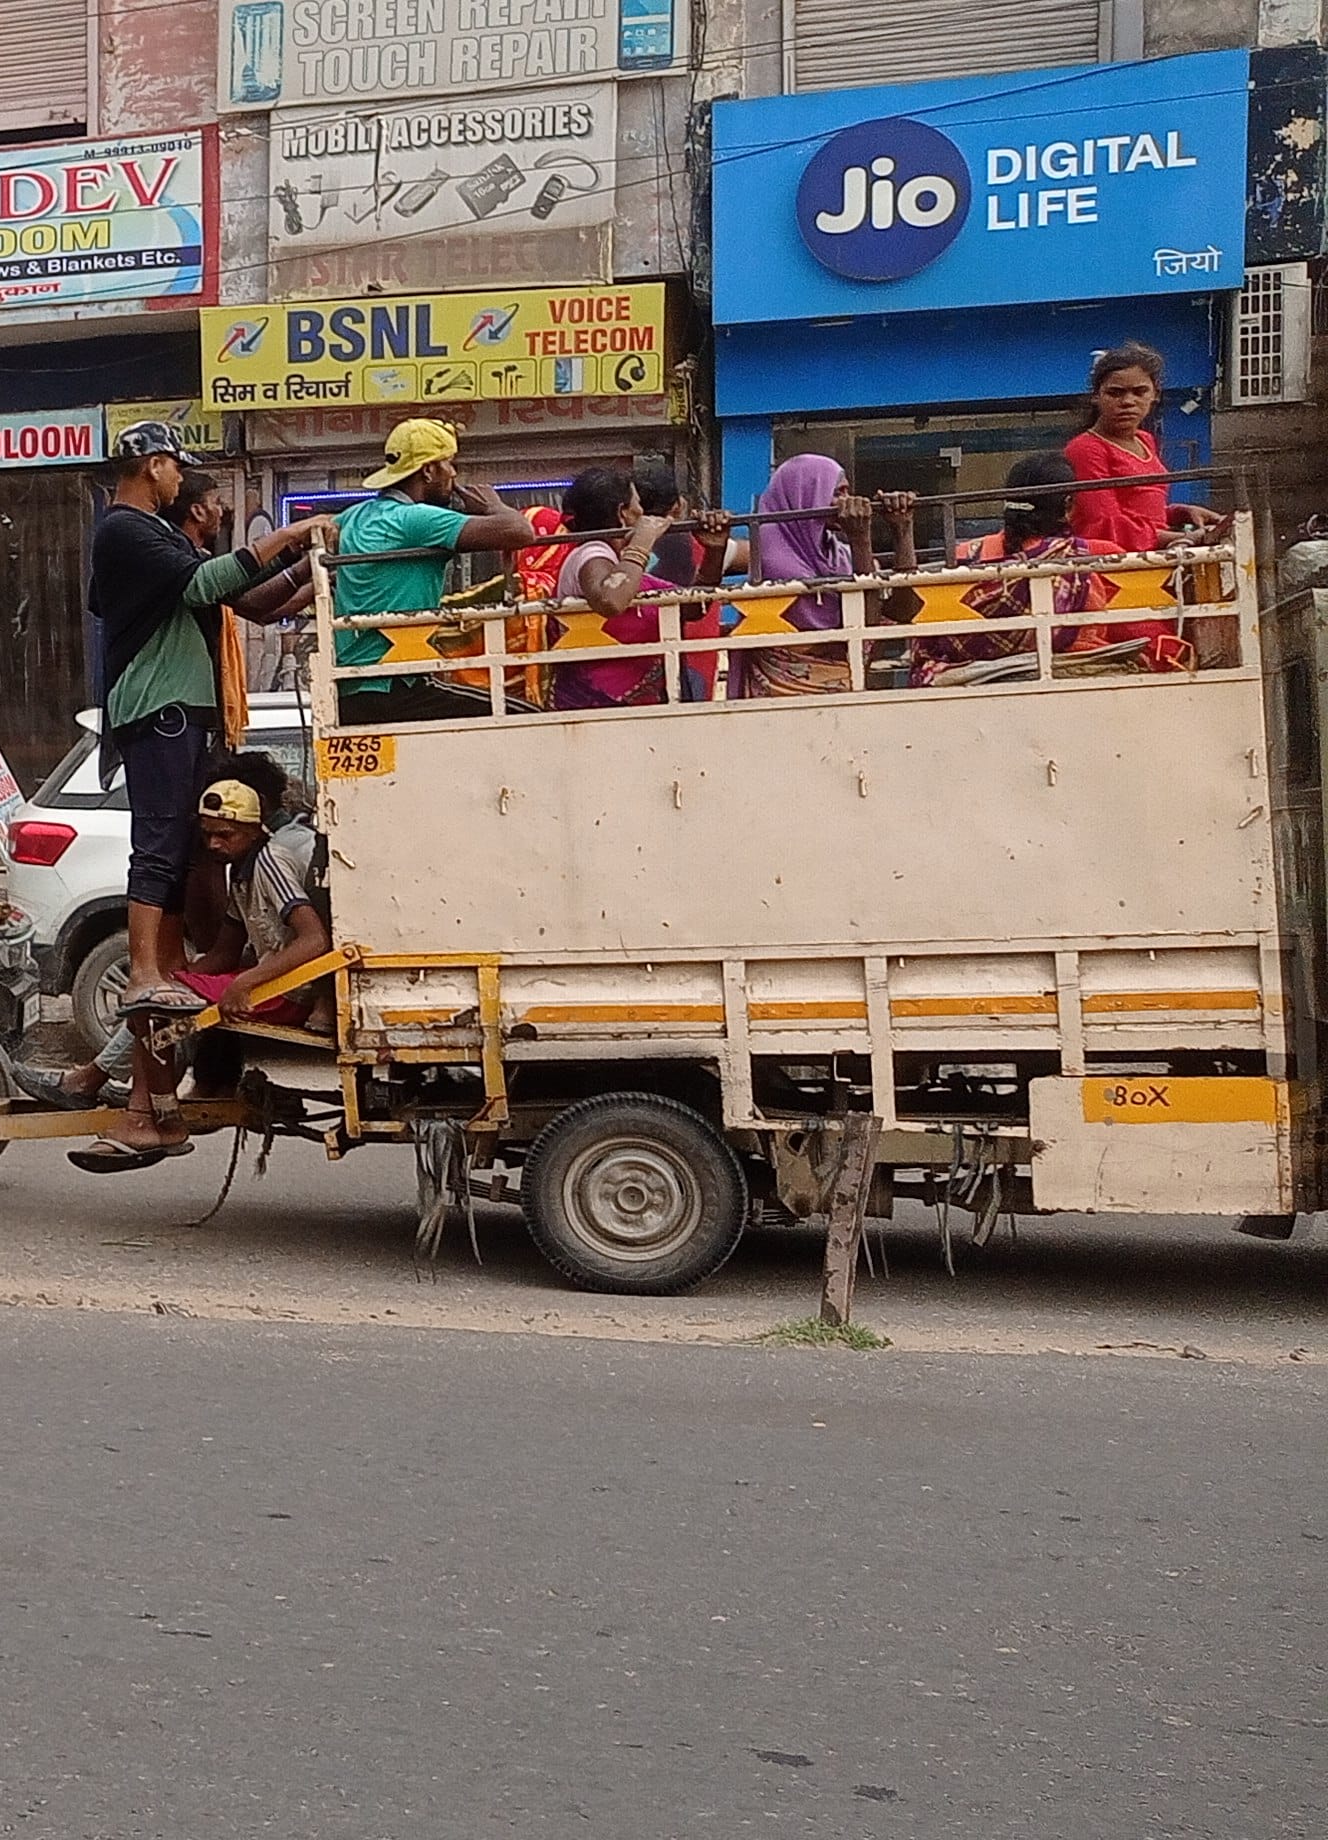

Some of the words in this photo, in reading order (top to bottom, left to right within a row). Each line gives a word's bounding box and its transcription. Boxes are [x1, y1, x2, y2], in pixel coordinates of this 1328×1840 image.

[292, 0, 443, 46] SCREEN
[298, 39, 436, 97] TOUCH
[450, 26, 598, 84] REPAIR
[281, 119, 385, 158] MOBIL
[389, 103, 594, 148] ACCESSORIES
[815, 157, 956, 235] Jio
[987, 131, 1197, 186] DIGITAL
[987, 186, 1099, 231] LIFE
[27, 261, 43, 276] &
[48, 254, 135, 275] Blankets
[141, 250, 181, 266] Etc.
[1154, 245, 1222, 277] जियो
[287, 304, 448, 364] BSNL
[548, 296, 631, 324] VOICE
[524, 325, 654, 356] TELECOM
[212, 377, 256, 404] सिम
[263, 383, 279, 401] व
[286, 372, 353, 402] रिचार्ज
[327, 736, 381, 754] HR-65
